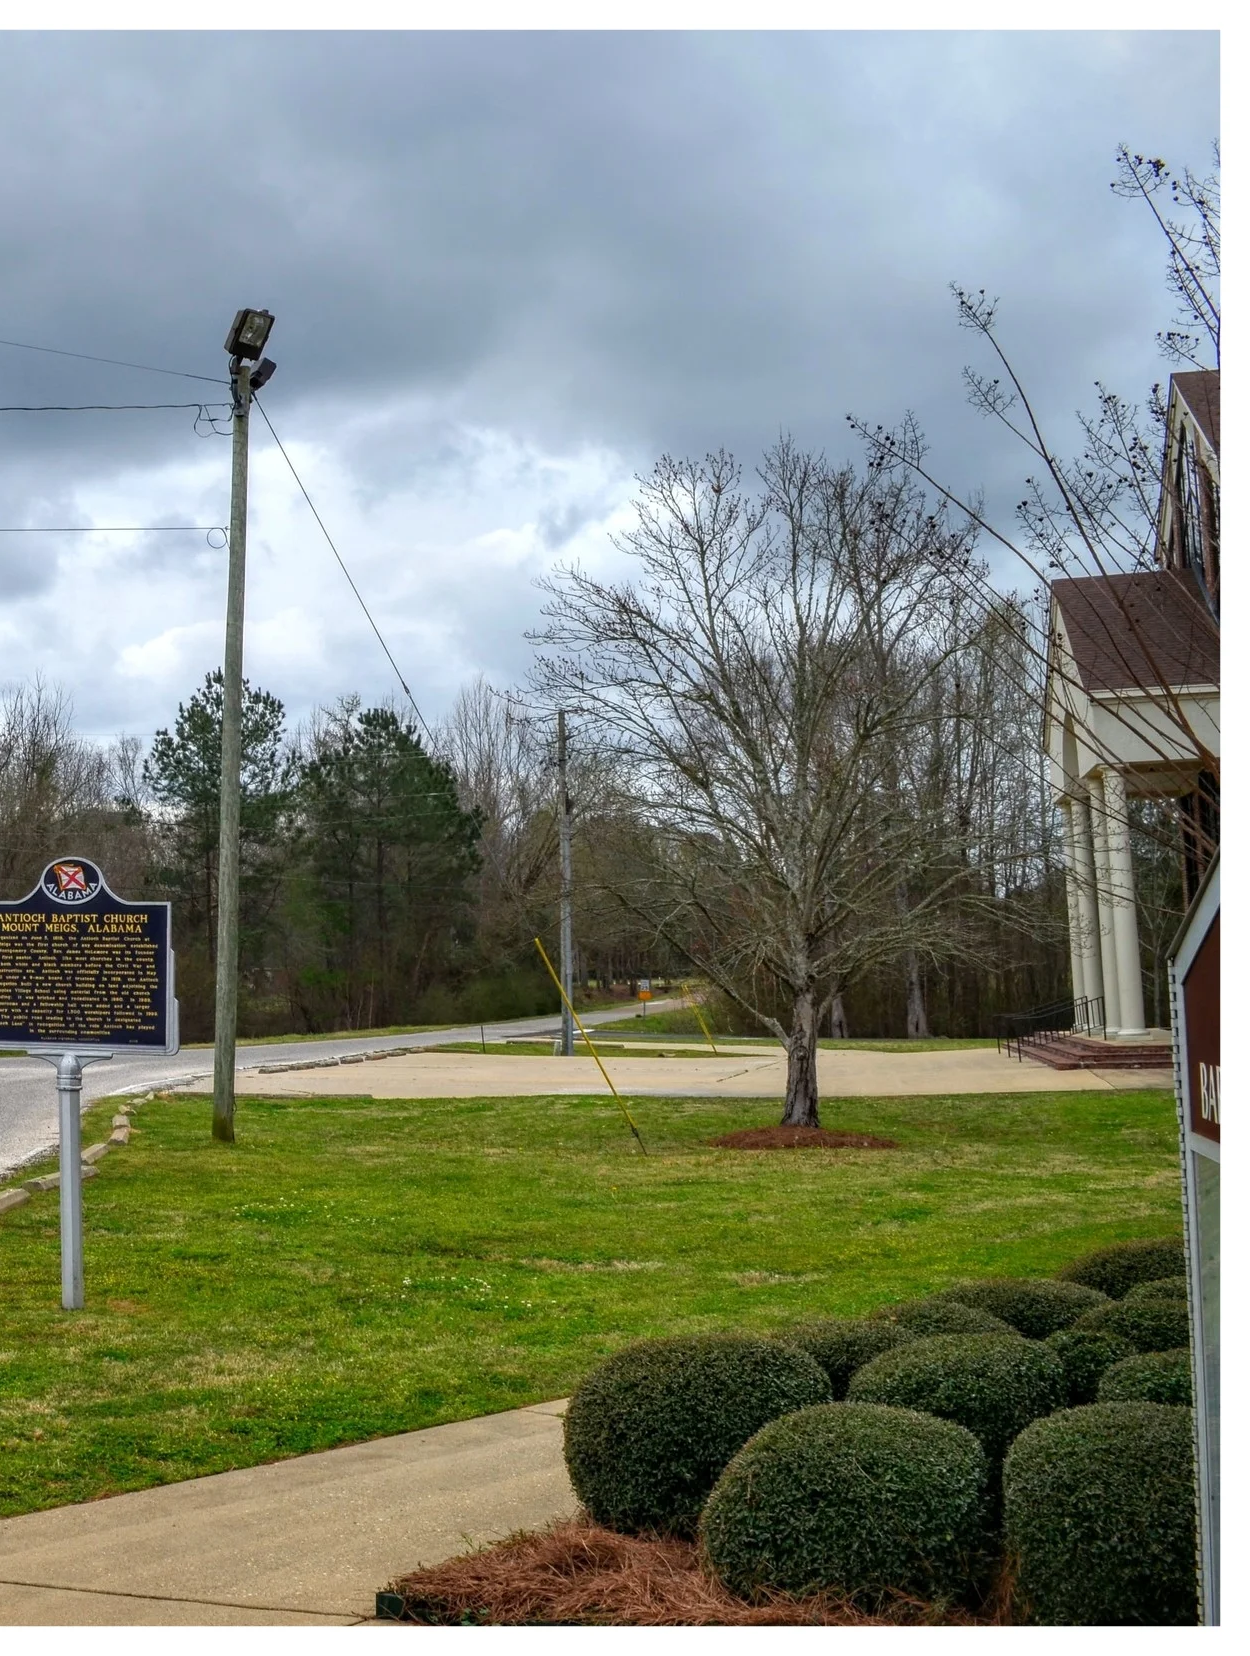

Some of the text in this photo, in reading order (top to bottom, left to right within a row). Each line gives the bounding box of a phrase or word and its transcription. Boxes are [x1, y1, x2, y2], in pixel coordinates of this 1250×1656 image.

[46, 883, 97, 900] ALABAMA
[52, 914, 98, 923] BAPTIST
[104, 914, 148, 924] CHURCH
[2, 924, 40, 932] MOUNT
[88, 924, 142, 934] ALABAMA
